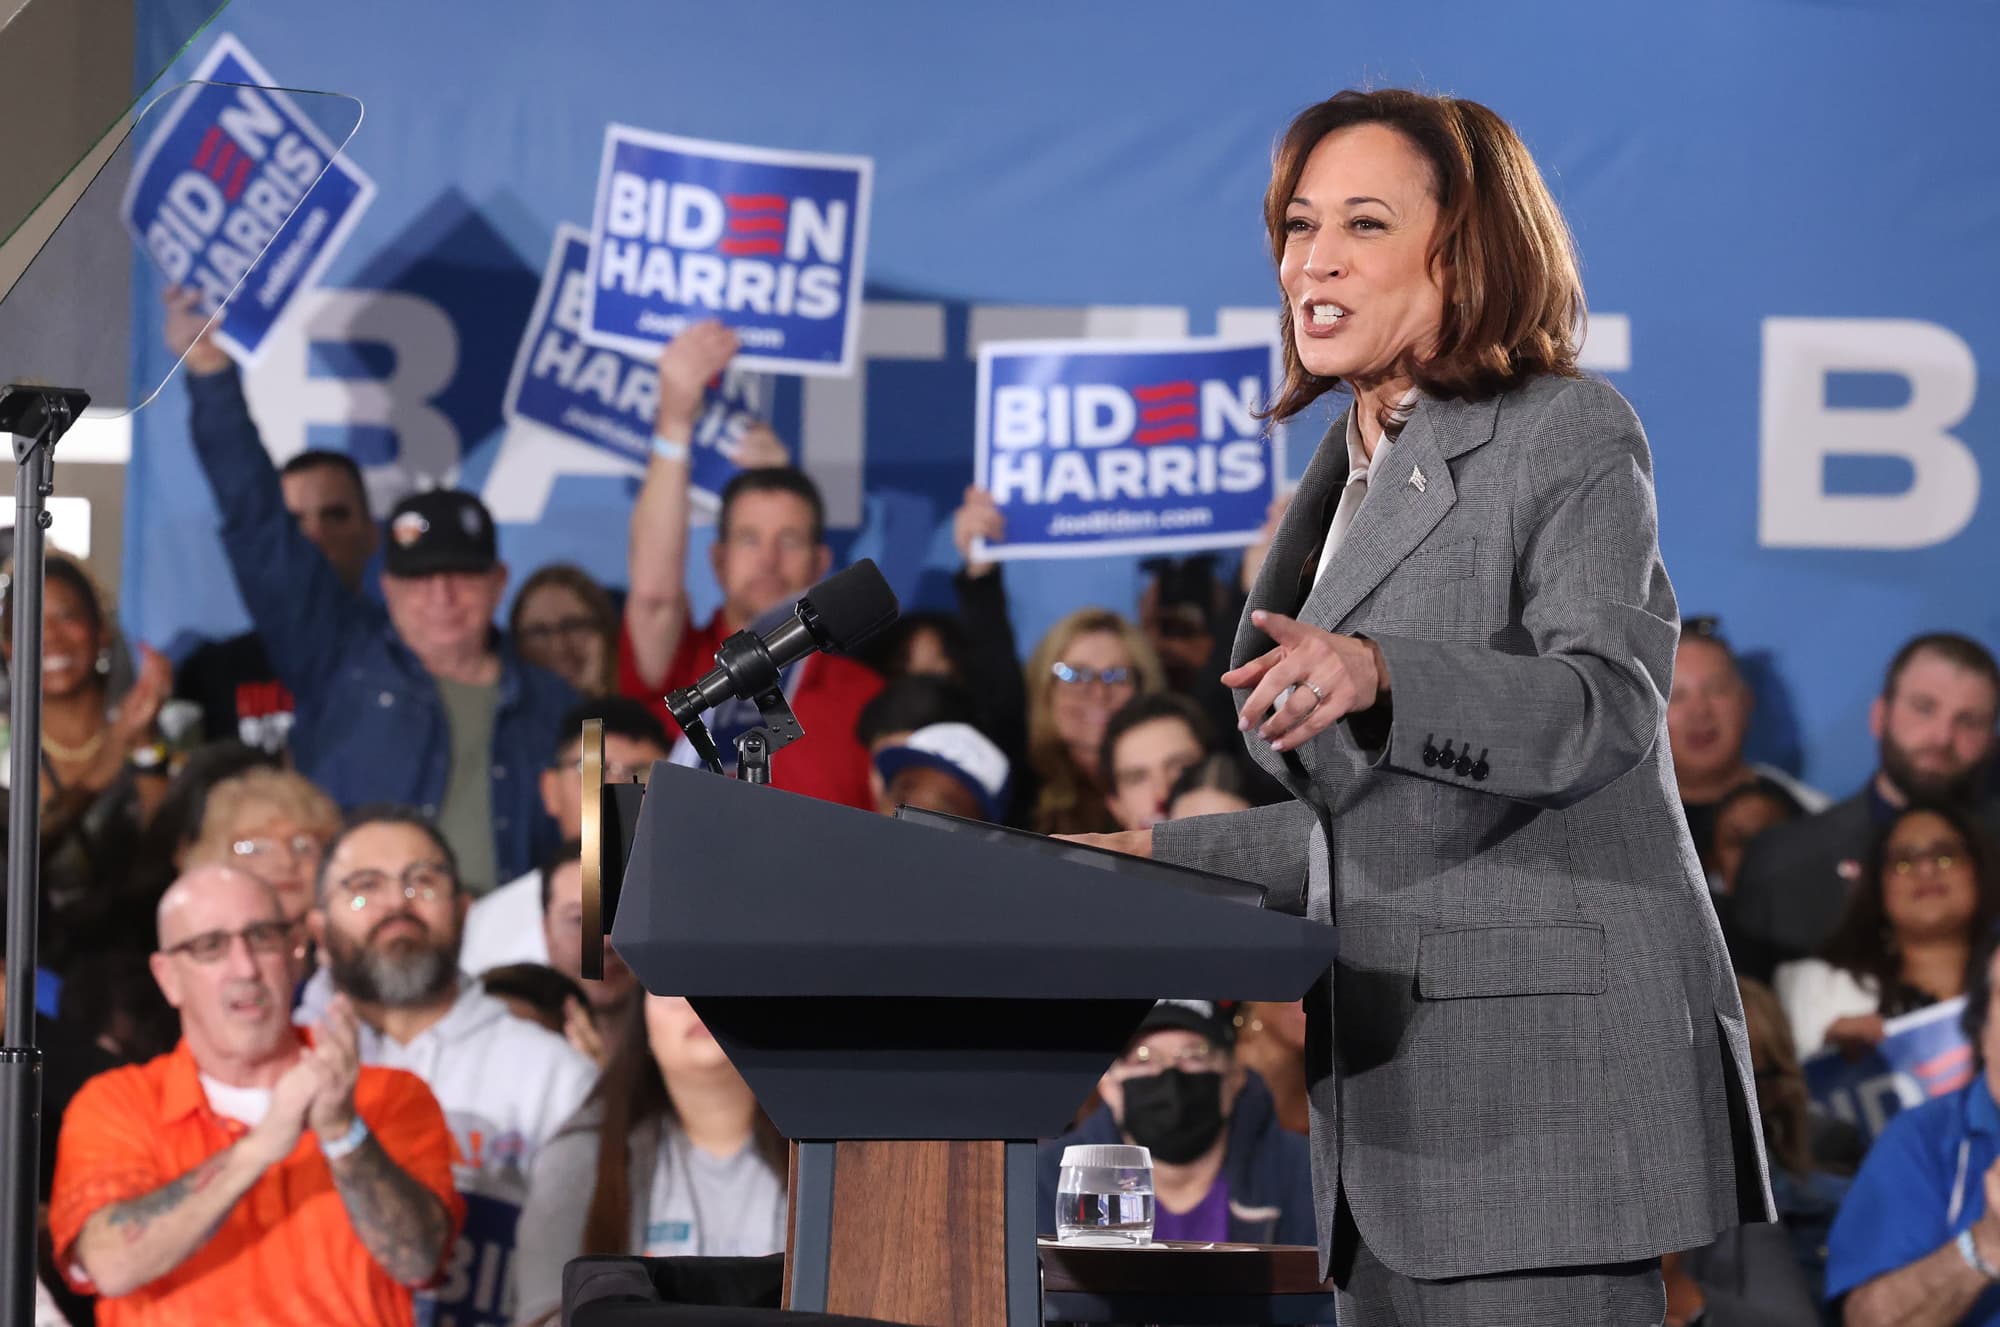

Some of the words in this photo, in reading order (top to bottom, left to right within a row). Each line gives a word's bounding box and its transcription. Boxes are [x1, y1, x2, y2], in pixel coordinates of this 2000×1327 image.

[606, 171, 847, 264] BIDEN
[600, 238, 842, 319] HARRIS
[993, 376, 1261, 449] BIDEN
[991, 441, 1267, 504] HARRIS
[1047, 506, 1213, 536] JoeBiden.com
